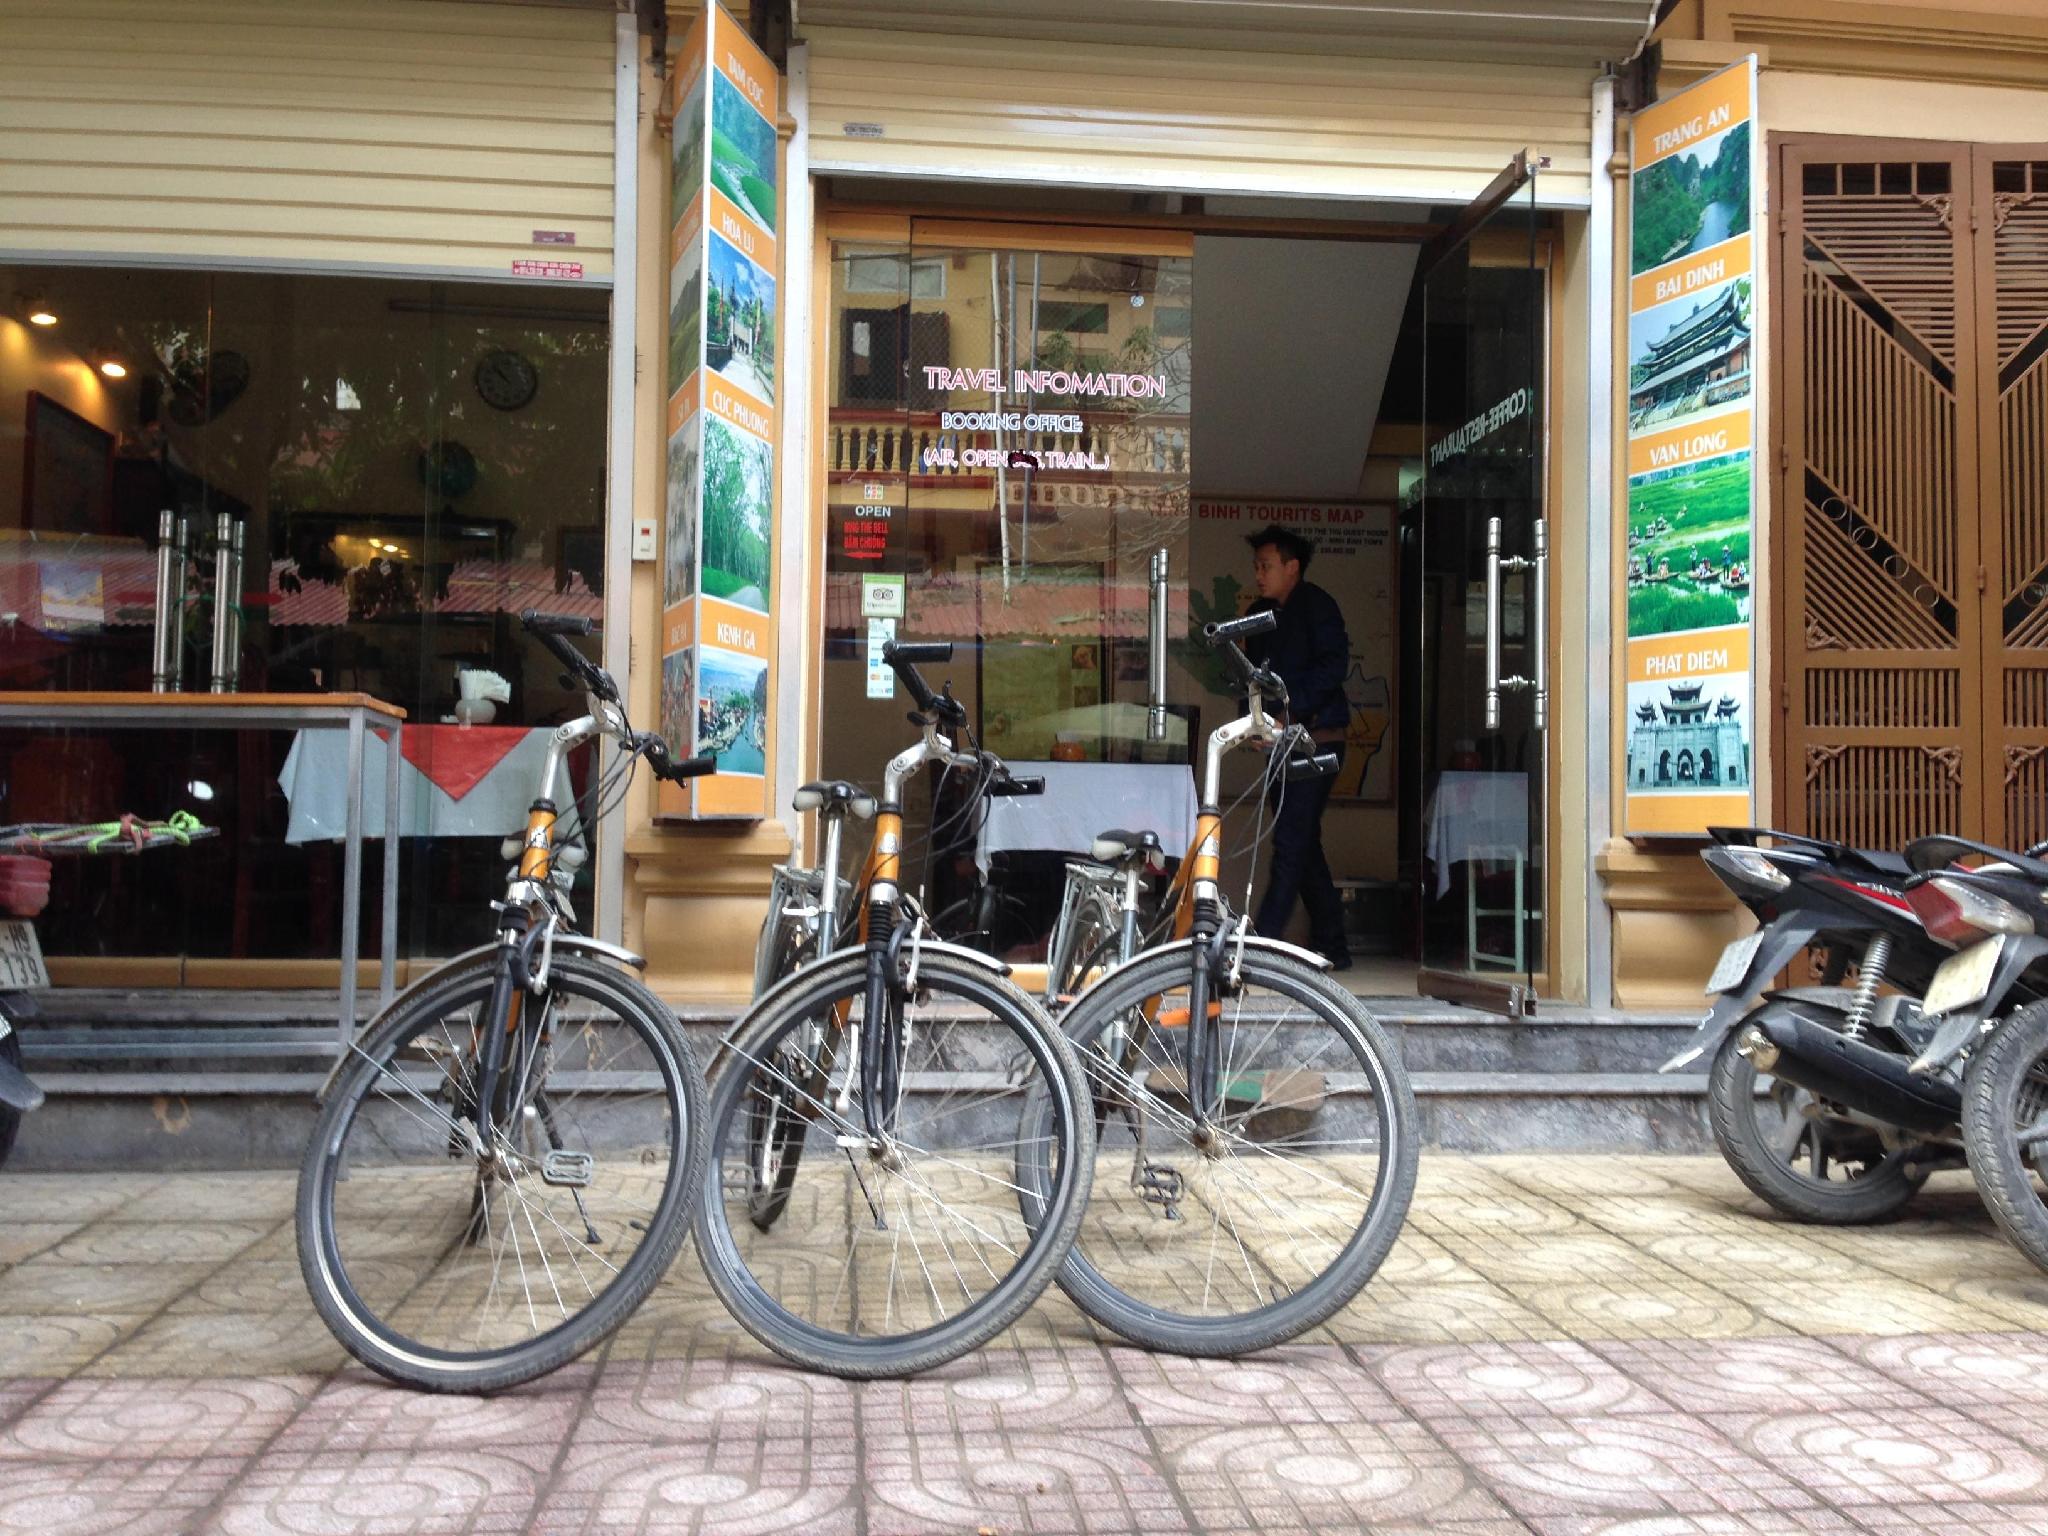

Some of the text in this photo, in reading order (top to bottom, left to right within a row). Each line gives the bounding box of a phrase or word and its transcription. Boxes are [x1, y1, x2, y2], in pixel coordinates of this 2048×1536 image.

[727, 52, 765, 107] TAM COC
[1653, 103, 1731, 154] TRANG AN
[722, 211, 743, 245] HOA
[744, 229, 755, 254] LU
[1655, 258, 1725, 301] BAI DINH
[923, 366, 1166, 397] TRAVEL INFOMATION
[712, 390, 769, 438] CUC PHUONG
[941, 411, 1020, 431] BOOKING
[961, 449, 1009, 468] OPEN
[1650, 429, 1728, 467] VAN LONG
[855, 505, 892, 518] OPEN
[1198, 505, 1241, 521] BINH
[1247, 506, 1322, 522] TOURITS
[1327, 509, 1365, 524] MAP
[717, 621, 756, 652] KENH GA
[1645, 647, 1728, 676] PHAT DIEM
